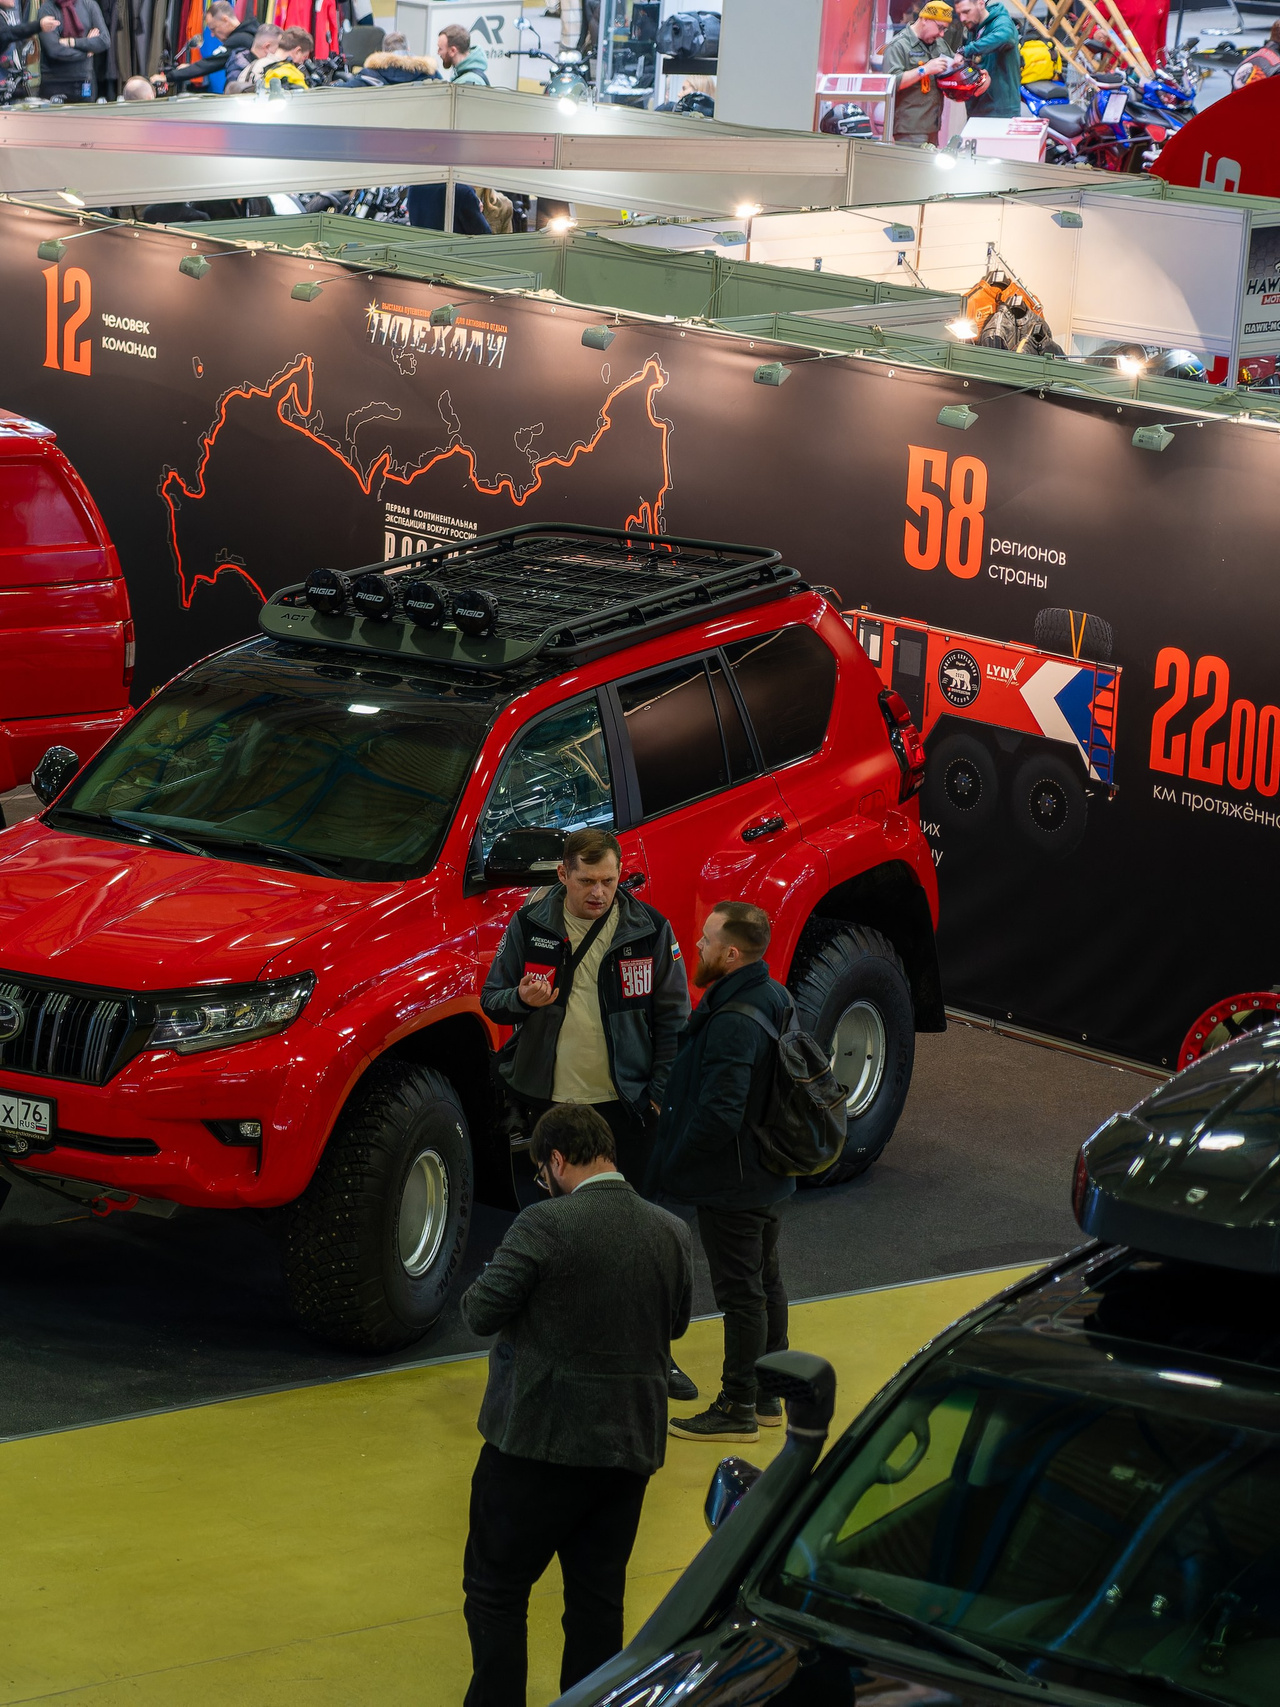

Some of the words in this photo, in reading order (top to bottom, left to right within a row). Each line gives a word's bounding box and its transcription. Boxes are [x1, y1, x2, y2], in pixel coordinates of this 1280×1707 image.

[41, 263, 92, 377] 12
[101, 312, 150, 335] человек
[101, 335, 158, 359] команда
[385, 502, 411, 516] ПЕРВАЯ
[413, 509, 478, 531] КОНТИНЕНТАЛЬНАЯ
[903, 444, 989, 579] 58
[385, 513, 426, 531] ЭКСПЕДИЦИЯ
[426, 523, 449, 536] ВОКРУГ
[450, 528, 478, 541] РОССИИ
[989, 537, 1067, 567] регионов
[988, 564, 1048, 590] страны
[308, 586, 337, 596] RIGID
[355, 591, 385, 603] RIGID
[406, 599, 435, 610] RIGID
[455, 607, 485, 619] RIGID
[986, 662, 1019, 681] LYNX
[1153, 784, 1177, 803] км
[21, 1101, 42, 1122] 76
[19, 1120, 36, 1130] RUS
